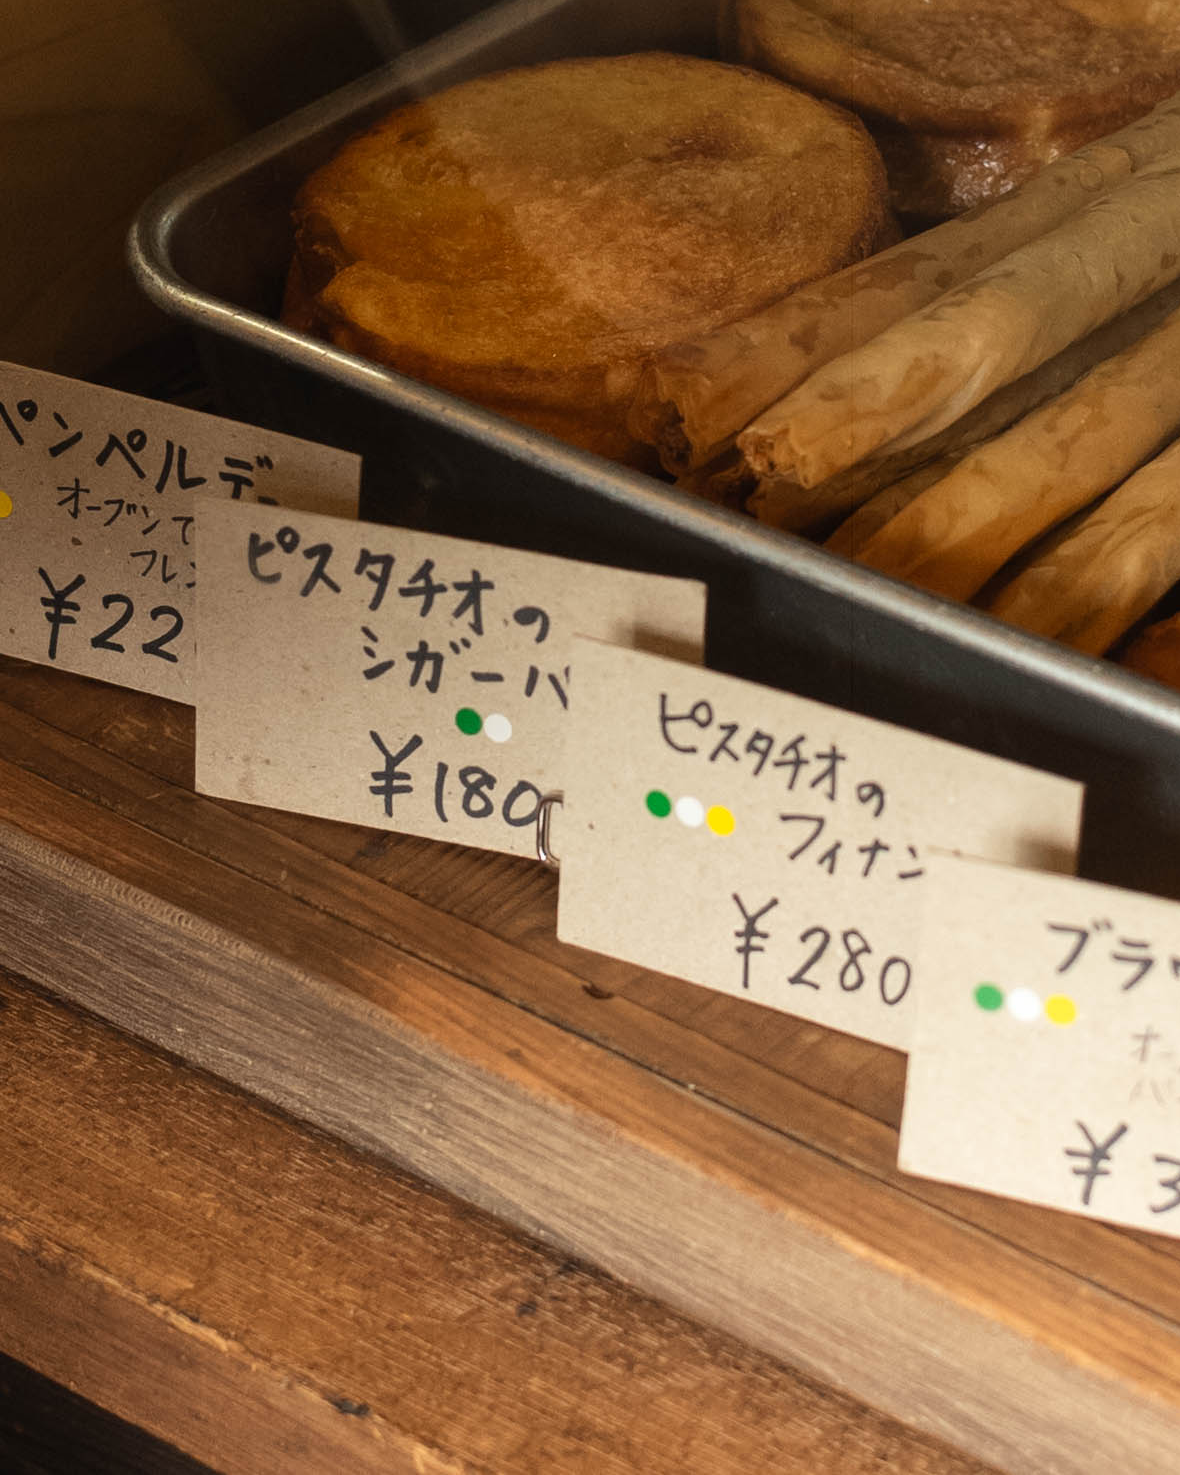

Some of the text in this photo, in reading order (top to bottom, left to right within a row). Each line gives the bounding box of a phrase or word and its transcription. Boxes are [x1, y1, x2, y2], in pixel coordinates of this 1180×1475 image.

[0, 398, 280, 507] パンペルデ
[247, 524, 551, 644] ピスタチオの
[369, 729, 546, 828] ¥180
[658, 692, 886, 818] ピスタチオの
[779, 811, 926, 880] フィナン
[732, 892, 914, 1006] ¥280
